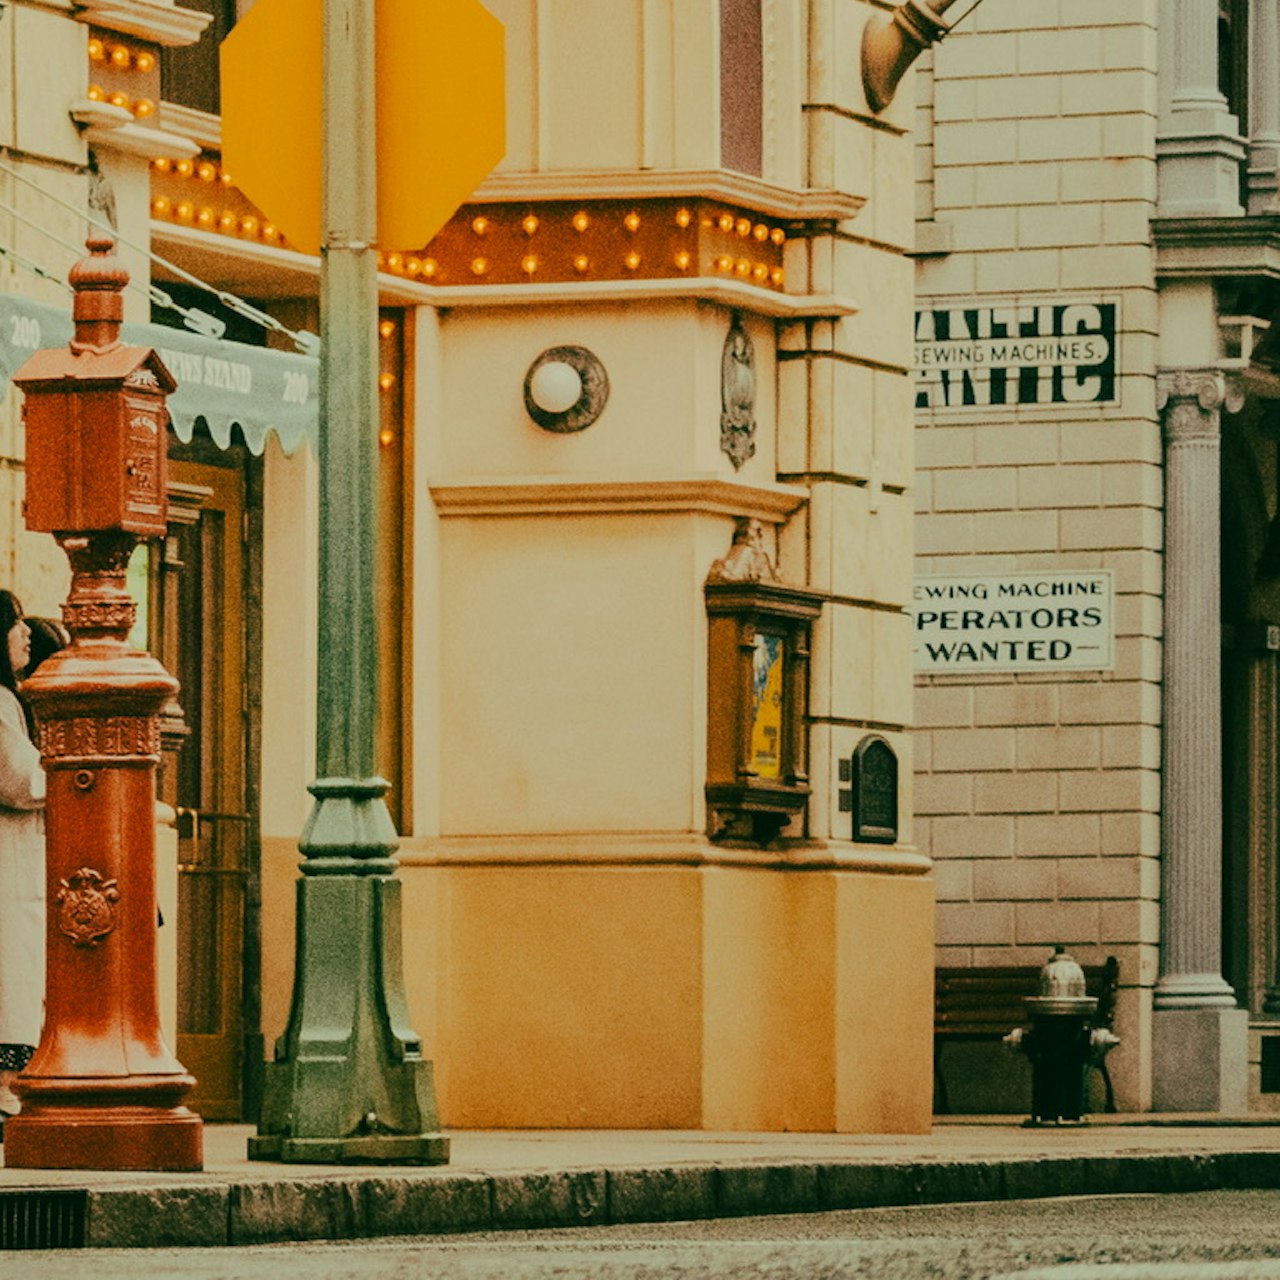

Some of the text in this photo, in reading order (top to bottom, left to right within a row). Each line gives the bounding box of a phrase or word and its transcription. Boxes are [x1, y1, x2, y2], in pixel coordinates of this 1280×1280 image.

[9, 315, 309, 406] 200 EWS STAND 200
[990, 341, 1103, 361] MACHINES.
[998, 580, 1103, 597] MACHINE
[917, 607, 1102, 631] PERATORS
[925, 639, 1072, 662] WANTED
